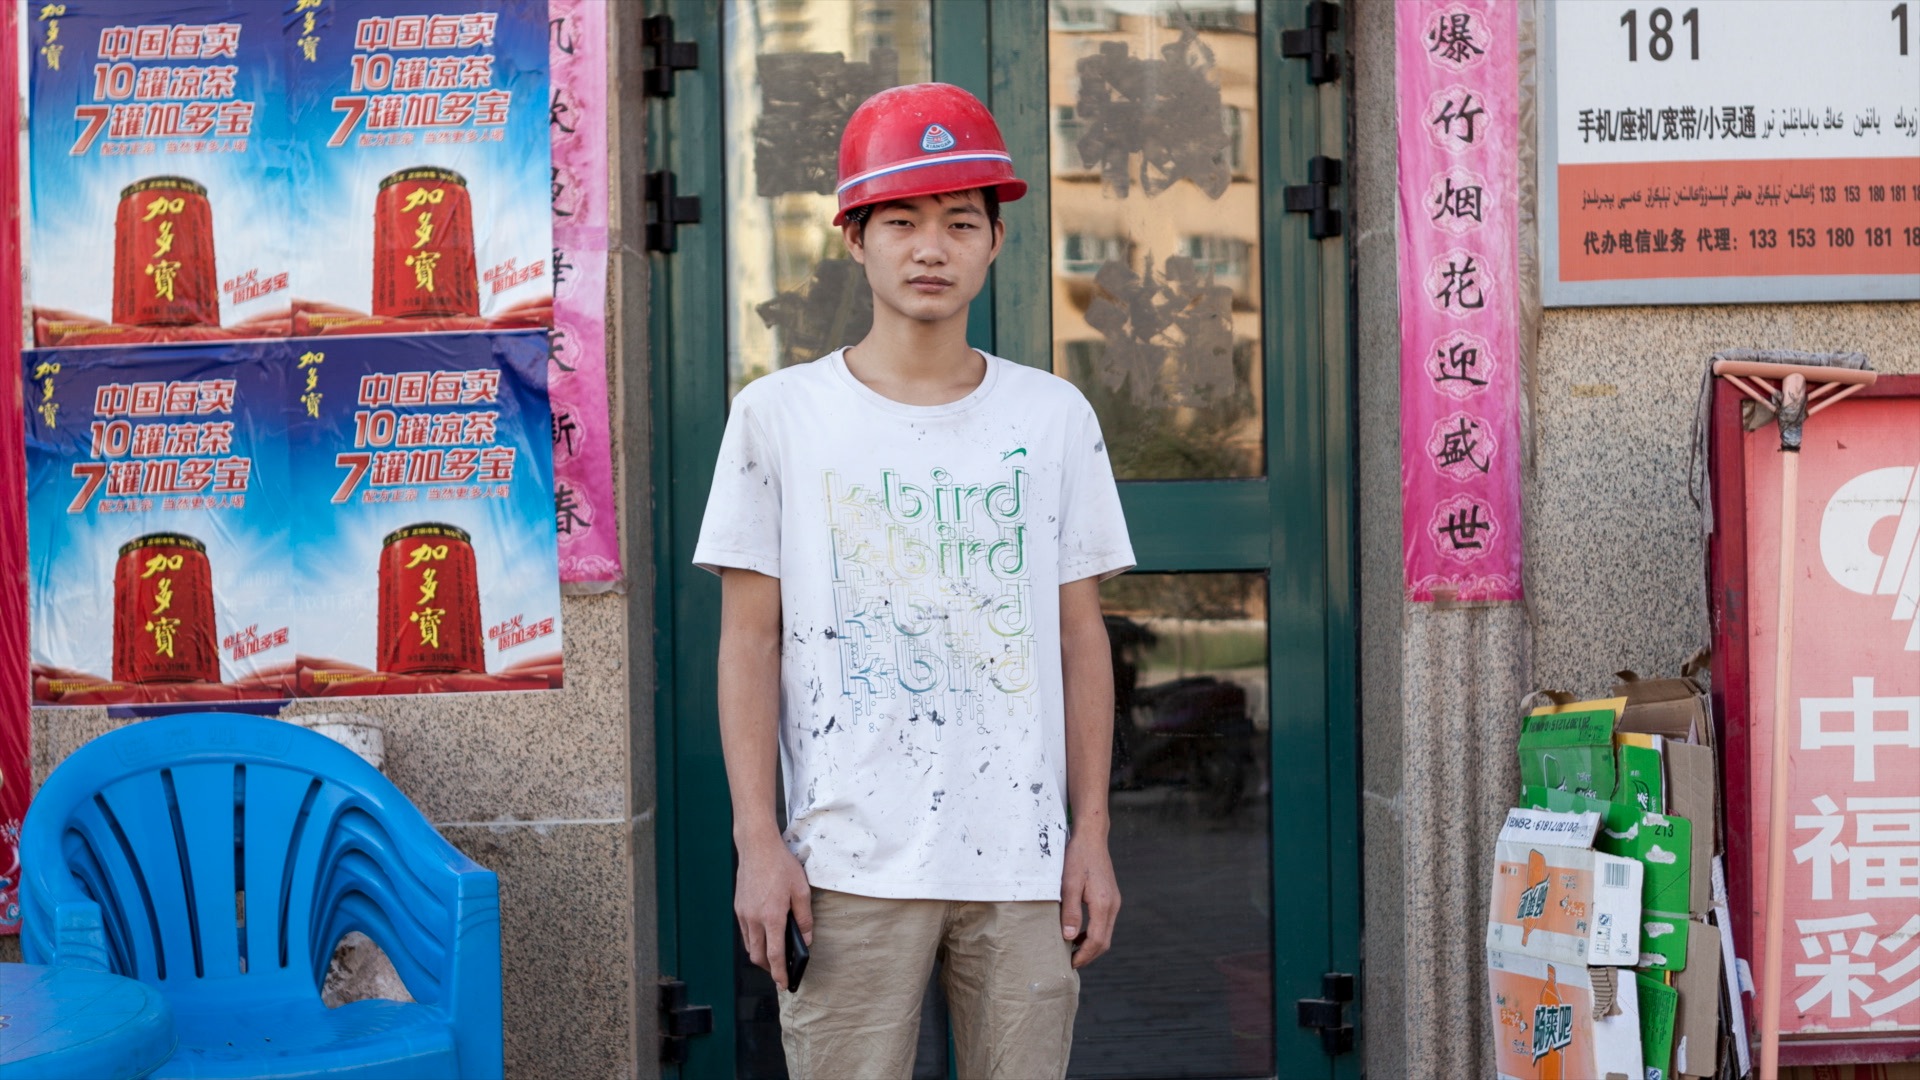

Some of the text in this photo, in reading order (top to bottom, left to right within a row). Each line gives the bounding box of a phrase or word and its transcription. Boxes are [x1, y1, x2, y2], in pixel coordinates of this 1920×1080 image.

[97, 23, 242, 61] 中国每卖
[354, 12, 498, 51] 中国每卖
[1621, 7, 1700, 62] 181
[93, 63, 239, 101] 10罐凉茶
[350, 54, 495, 92] 10罐凉茶
[69, 99, 255, 156] 7罐加多宝
[326, 90, 511, 147] 7罐加多宝
[1577, 105, 1757, 143] 手机/座机/宽带/小灵通
[1820, 185, 1836, 202] 133
[1844, 185, 1860, 202] 153
[1869, 185, 1885, 202] 180
[1890, 185, 1906, 202] 181
[1583, 228, 1686, 255] 代办电信业务
[1749, 228, 1777, 248] 133
[1788, 228, 1816, 248] 153
[1826, 227, 1854, 248] 180
[1865, 227, 1892, 247] 181
[1429, 13, 1490, 549] 爆竹烟花迎盛世
[95, 379, 236, 418] 中国每卖
[358, 369, 501, 408] 中国每卖
[90, 420, 236, 458] 10罐凉茶
[354, 410, 498, 449] 10罐凉茶
[68, 456, 251, 514] 7罐加多宝
[330, 446, 516, 504] 7罐加多宝
